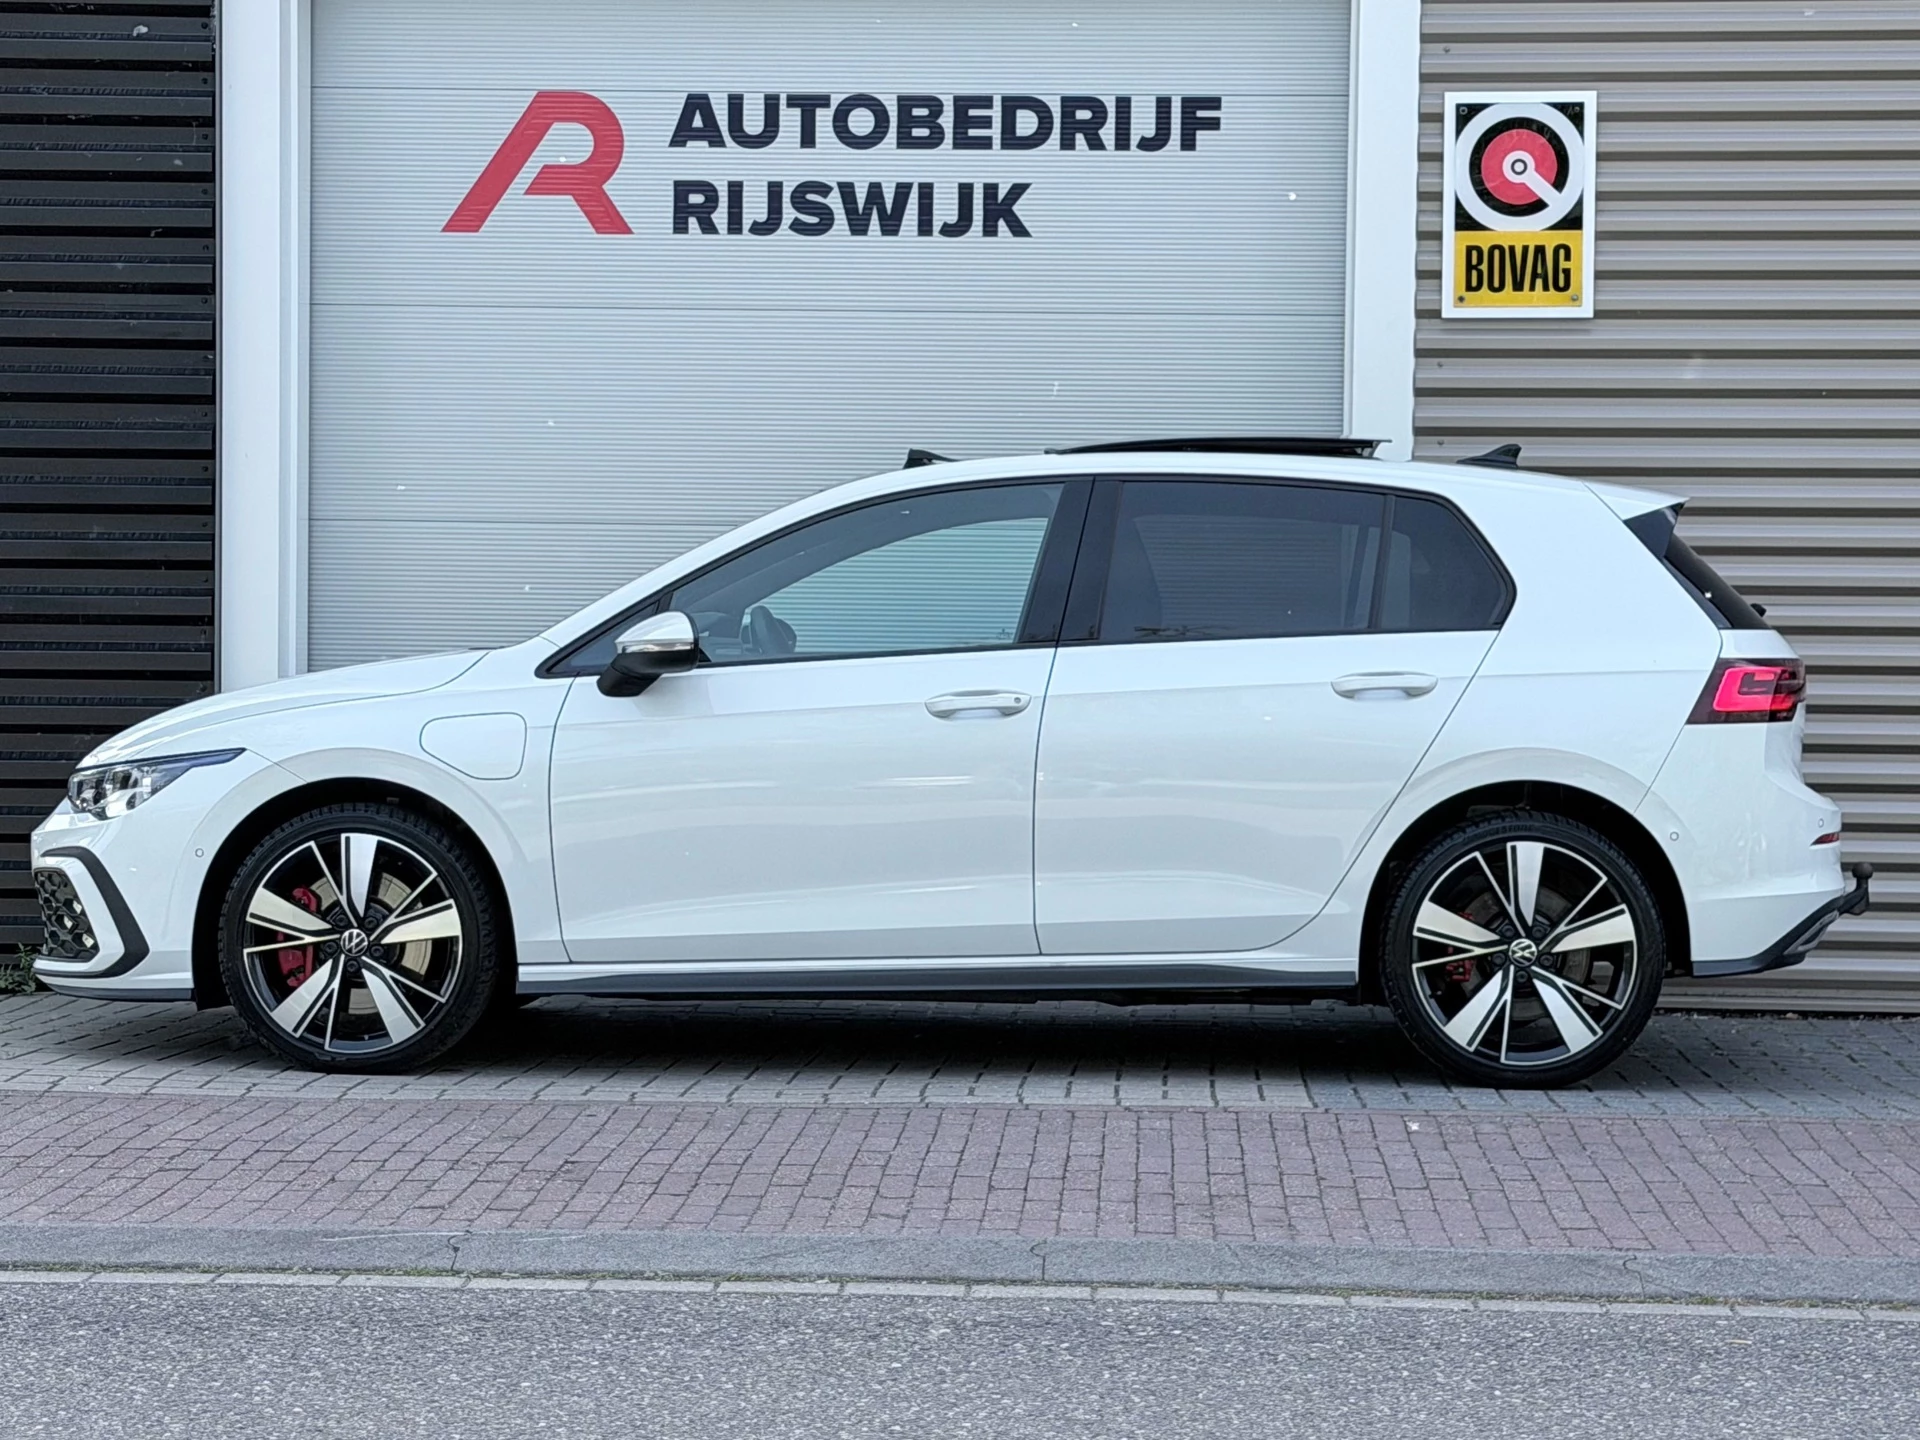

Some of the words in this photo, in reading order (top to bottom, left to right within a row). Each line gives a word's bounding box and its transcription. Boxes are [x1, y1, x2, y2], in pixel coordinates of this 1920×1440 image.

[668, 92, 1223, 152] AUTOBEDRIJF
[672, 180, 1033, 238] RIJSWIJK
[1464, 243, 1572, 294] BOVAG
